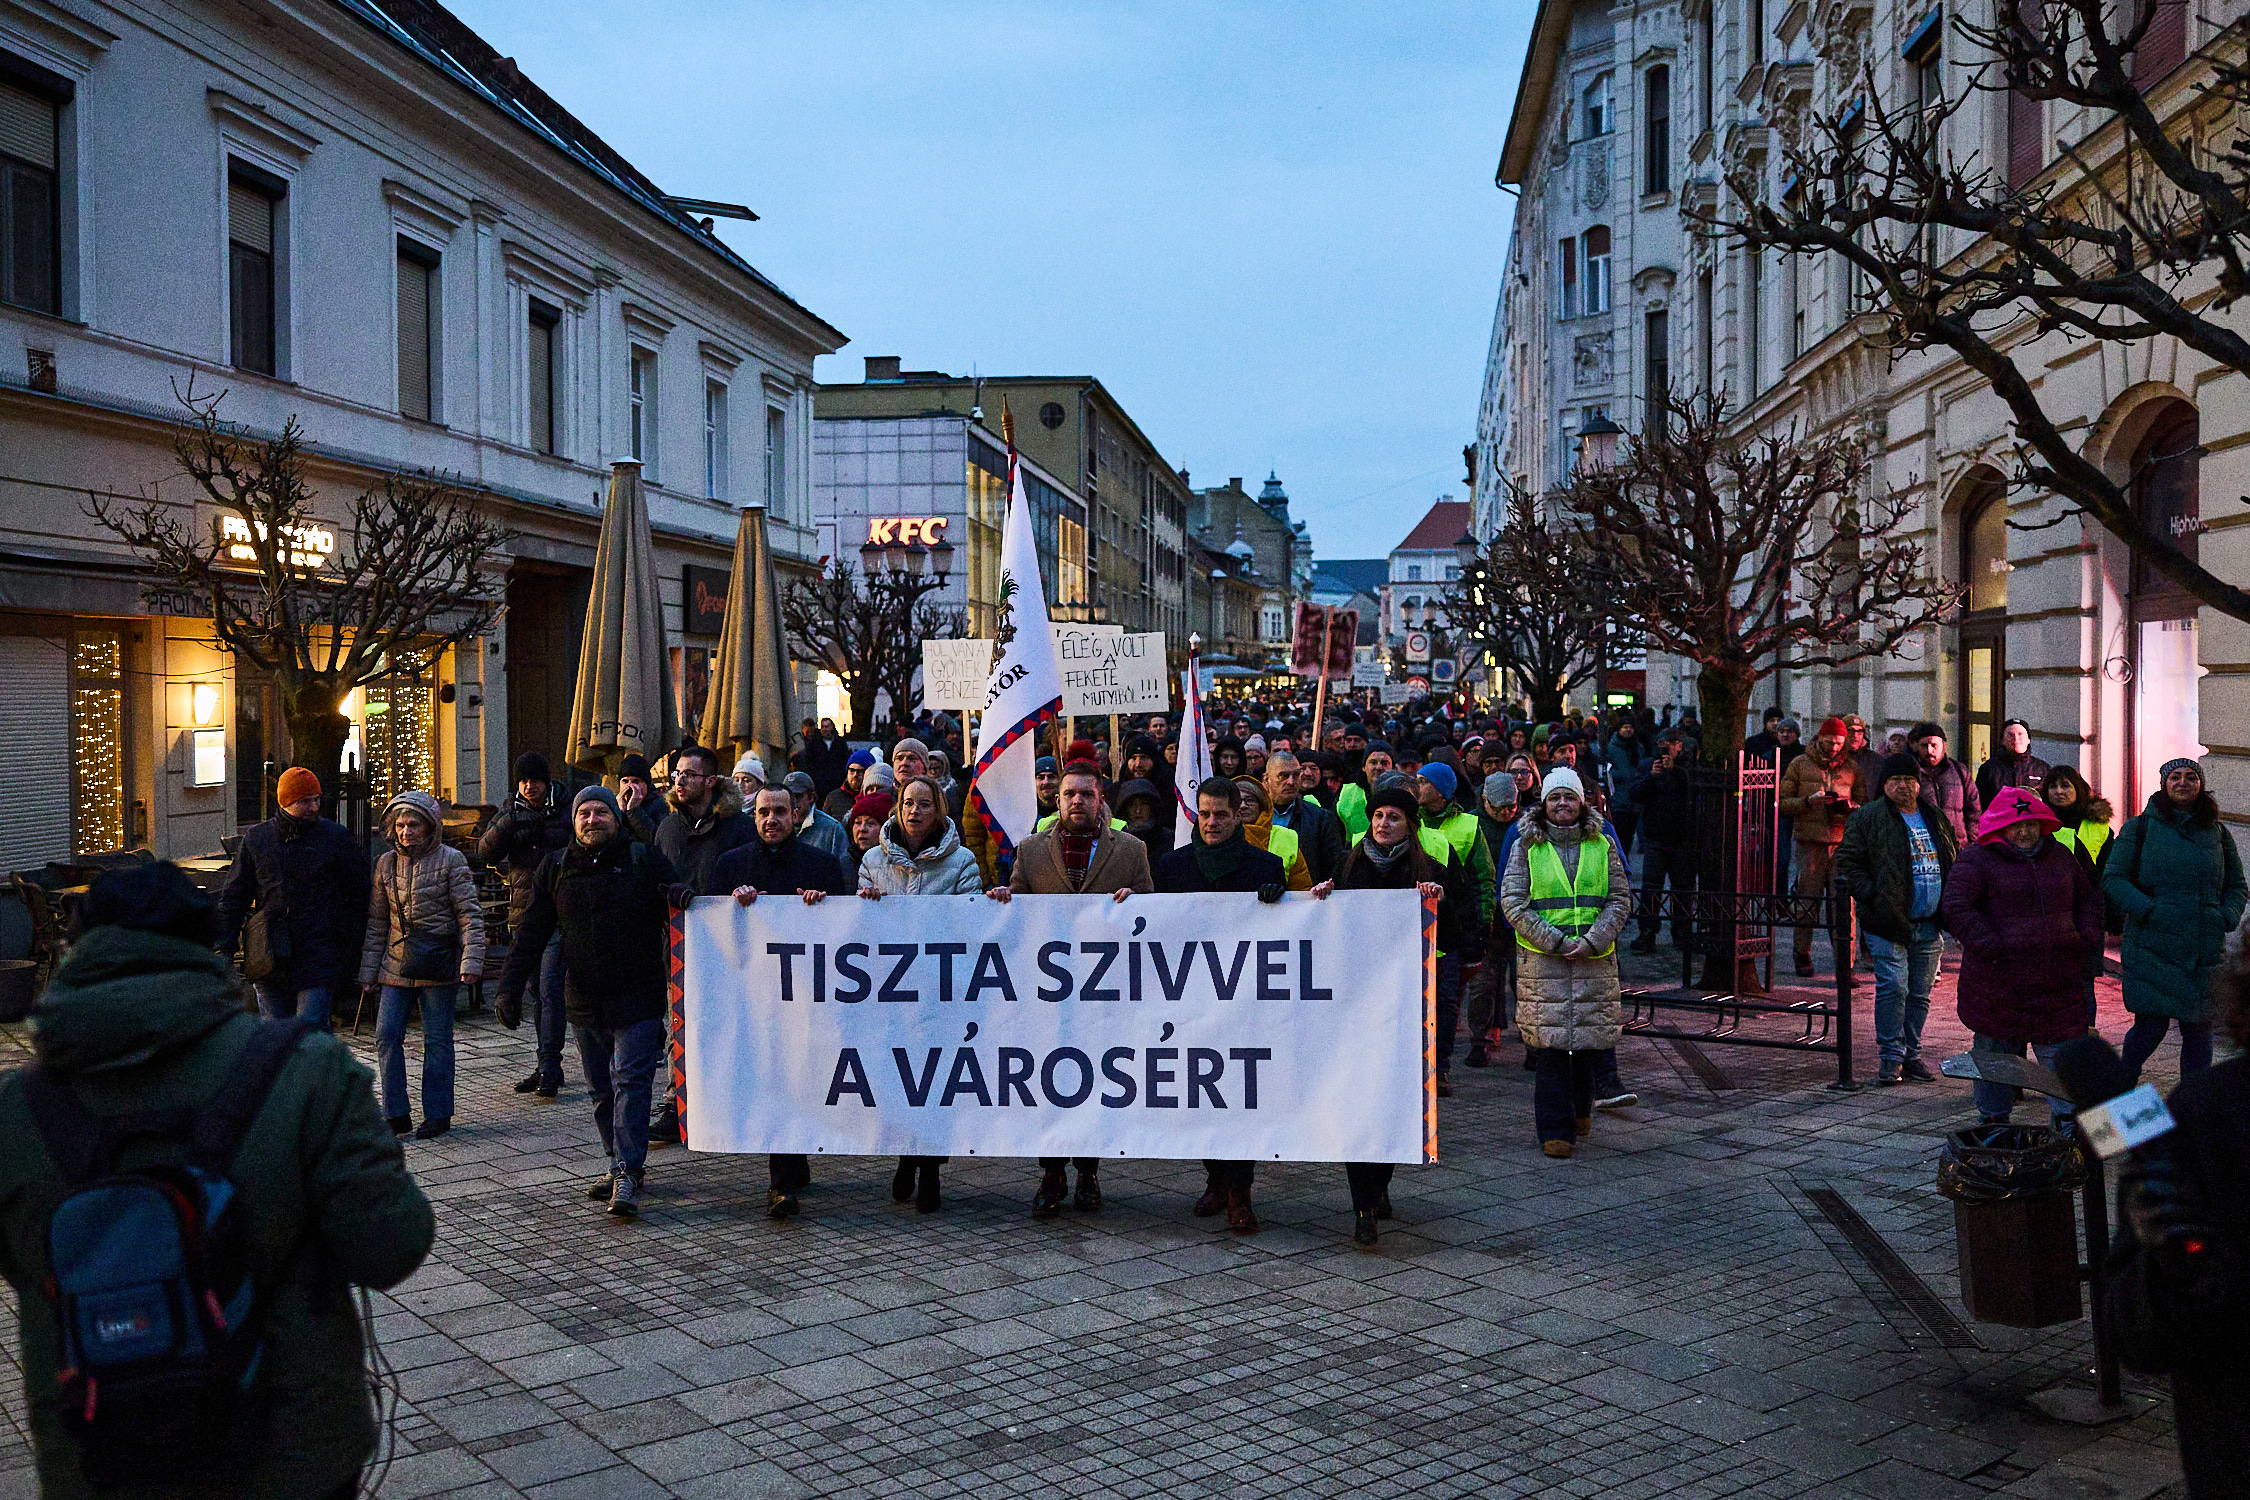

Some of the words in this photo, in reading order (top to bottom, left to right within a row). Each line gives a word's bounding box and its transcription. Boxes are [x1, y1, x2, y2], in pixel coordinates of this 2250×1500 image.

[866, 516, 948, 546] KFC
[924, 642, 948, 658] HOL
[952, 642, 975, 658] VAN
[977, 642, 986, 658] A
[1062, 637, 1102, 659] ELÉG
[1112, 635, 1148, 658] VOLT
[1103, 653, 1116, 668] A
[1065, 668, 1119, 688] FEKETE
[1913, 864, 1941, 875] 2026
[767, 943, 1017, 1003] TISZTA
[1038, 917, 1332, 1002] SZÍVVEL
[825, 1048, 876, 1107] A
[892, 1022, 1271, 1109] VÁROSÉRT
